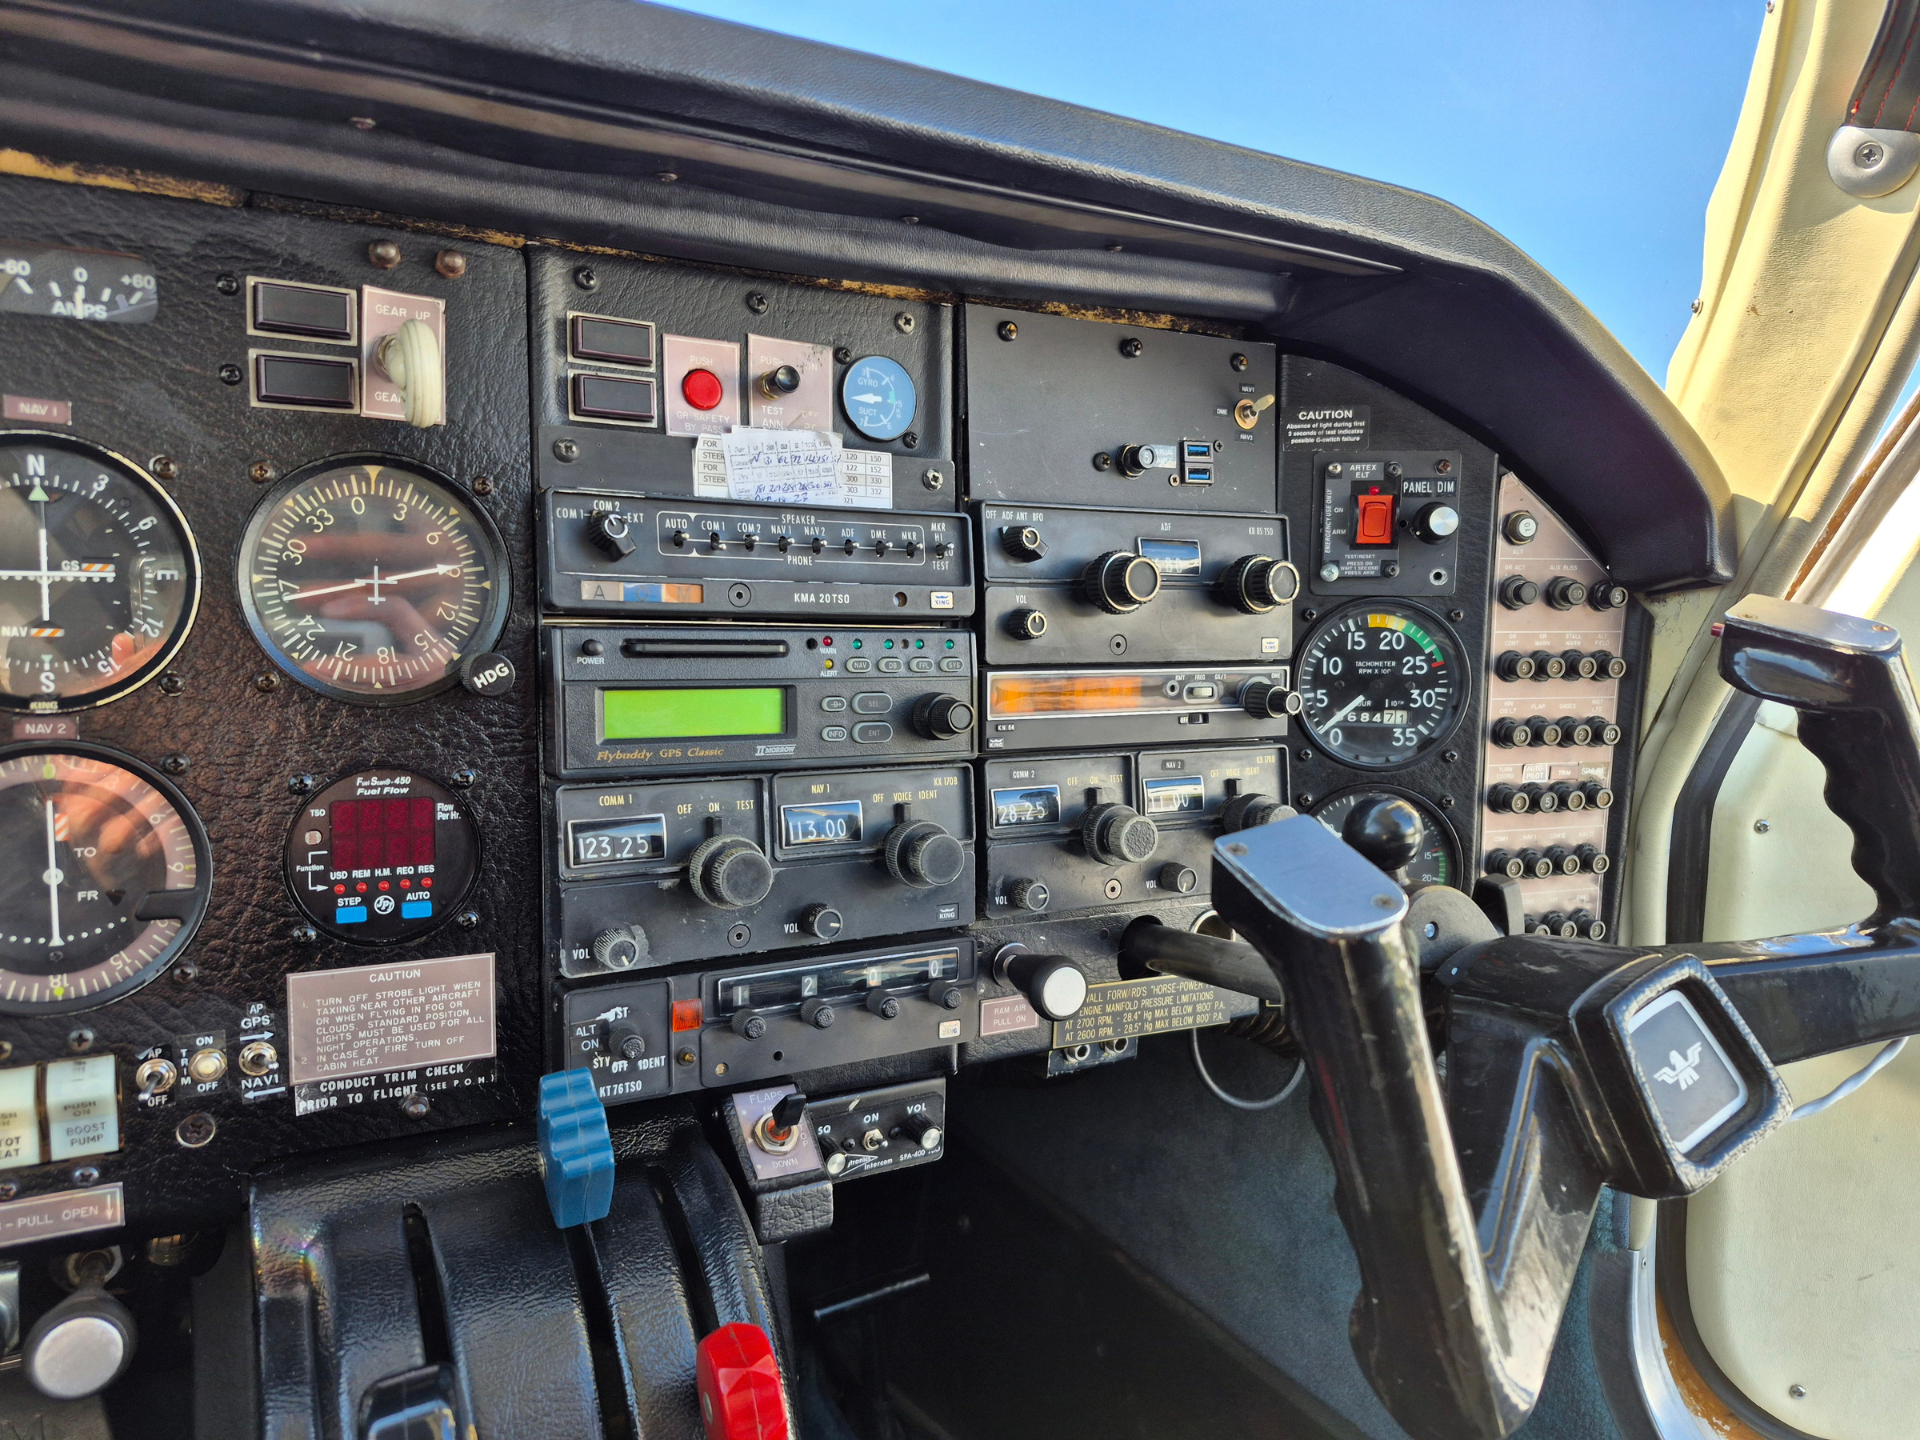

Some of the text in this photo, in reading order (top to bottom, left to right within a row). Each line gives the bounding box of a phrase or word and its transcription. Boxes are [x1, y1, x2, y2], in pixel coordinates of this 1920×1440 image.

[74, 267, 88, 282] 0
[120, 274, 155, 289] +60
[375, 304, 431, 320] GEAR UP
[690, 356, 713, 365] PUSH
[761, 356, 783, 366] PUSH
[858, 377, 878, 388] GYRO
[762, 406, 783, 415] TEST
[859, 407, 877, 416] SUCT
[1299, 410, 1353, 420] CAUTION
[677, 412, 730, 423] GR SAFETY
[685, 423, 698, 431] BY
[703, 452, 724, 460] STEER
[27, 455, 44, 476] N
[93, 475, 109, 491] 3
[1404, 481, 1454, 493] PANEL DIM
[627, 513, 644, 523] EXT
[781, 514, 815, 525] SPEAKER
[985, 510, 997, 519] OFF
[1001, 511, 1014, 520] ADF
[1016, 512, 1028, 521] ANT
[1032, 513, 1044, 522] BFO
[306, 508, 334, 533] 33
[665, 519, 688, 529] AUTO
[841, 528, 854, 537] ADF
[931, 522, 946, 532] MKR
[1161, 523, 1171, 531] ADF
[871, 530, 886, 539] DME
[902, 531, 917, 540] MKR
[282, 539, 307, 565] 30
[787, 555, 812, 565] PHONE
[932, 561, 949, 570] TEST
[1015, 595, 1027, 604] VOL
[437, 601, 456, 621] 12
[141, 618, 164, 638] 12
[414, 630, 438, 651] 15
[1348, 632, 1366, 650] 15
[1379, 632, 1405, 650] 20
[335, 641, 357, 662] 21
[377, 646, 398, 664] 18
[577, 657, 605, 665] POWER
[1323, 657, 1342, 675] 10
[1402, 656, 1427, 674] 25
[473, 662, 509, 688] HDG
[40, 673, 55, 692] S
[1316, 690, 1328, 707] 5
[1410, 690, 1435, 708] 30
[25, 723, 66, 734] NAV 2
[1330, 728, 1342, 745] 0
[1392, 728, 1417, 746] 35
[1517, 732, 1524, 740] 10
[989, 739, 1004, 747] KING
[596, 748, 724, 762] Flybuddy GPS Classic
[1245, 767, 1260, 775] IDENT
[933, 777, 958, 786] KX 170B
[1067, 777, 1078, 785] OFF
[1090, 776, 1098, 784] ON
[873, 794, 884, 802] OFF
[893, 792, 912, 801] VOICE
[919, 790, 937, 799] IDENT
[677, 804, 692, 814] OFF
[709, 802, 720, 812] ON
[736, 800, 754, 810] TEST
[790, 818, 846, 841] 113.00
[579, 834, 649, 859] 123.25
[1511, 865, 1516, 873] 5
[1541, 865, 1545, 873] 2
[1146, 880, 1157, 889] VOL
[338, 897, 361, 906] STEP
[406, 892, 430, 901] AUTO
[573, 949, 590, 960] VOL
[110, 951, 132, 970] 15
[369, 969, 421, 983] CAUTION
[316, 990, 480, 1016] TAXIING NEAR OTHER AIRCRAFT
[1079, 991, 1214, 1016] ENGINE MANIFOLD PRESSURE LIMITATIONS
[316, 1017, 329, 1026] OR
[336, 1013, 364, 1023] WHEN
[371, 1008, 405, 1019] FLYING
[411, 1006, 421, 1014] IN
[426, 1002, 447, 1011] FOG
[241, 1015, 270, 1029] GPS
[316, 1009, 469, 1035] CLOUDS. STANDARD POSITION
[1077, 1030, 1095, 1039] 2600
[1144, 1022, 1152, 1032] Hg
[1155, 1018, 1169, 1028] MAX
[1172, 1017, 1193, 1027] BELOW
[1213, 1012, 1223, 1020] P.A.
[576, 1024, 596, 1036] ALT
[196, 1036, 213, 1046] ON
[317, 1036, 418, 1053] NIGHT OPERATIONS.
[180, 1049, 191, 1086] TRIM
[242, 1075, 279, 1089] NAV1
[320, 1063, 464, 1092] CONDUCT TRIM CHECK
[749, 1091, 784, 1104] FLAPS
[907, 1103, 926, 1114] VOL
[66, 1122, 106, 1136] BOOST
[71, 1134, 104, 1146] PUMP
[772, 1158, 798, 1168] DOWN
[864, 1158, 893, 1169] Intercom
[18, 1206, 98, 1228] PULL OPEN
